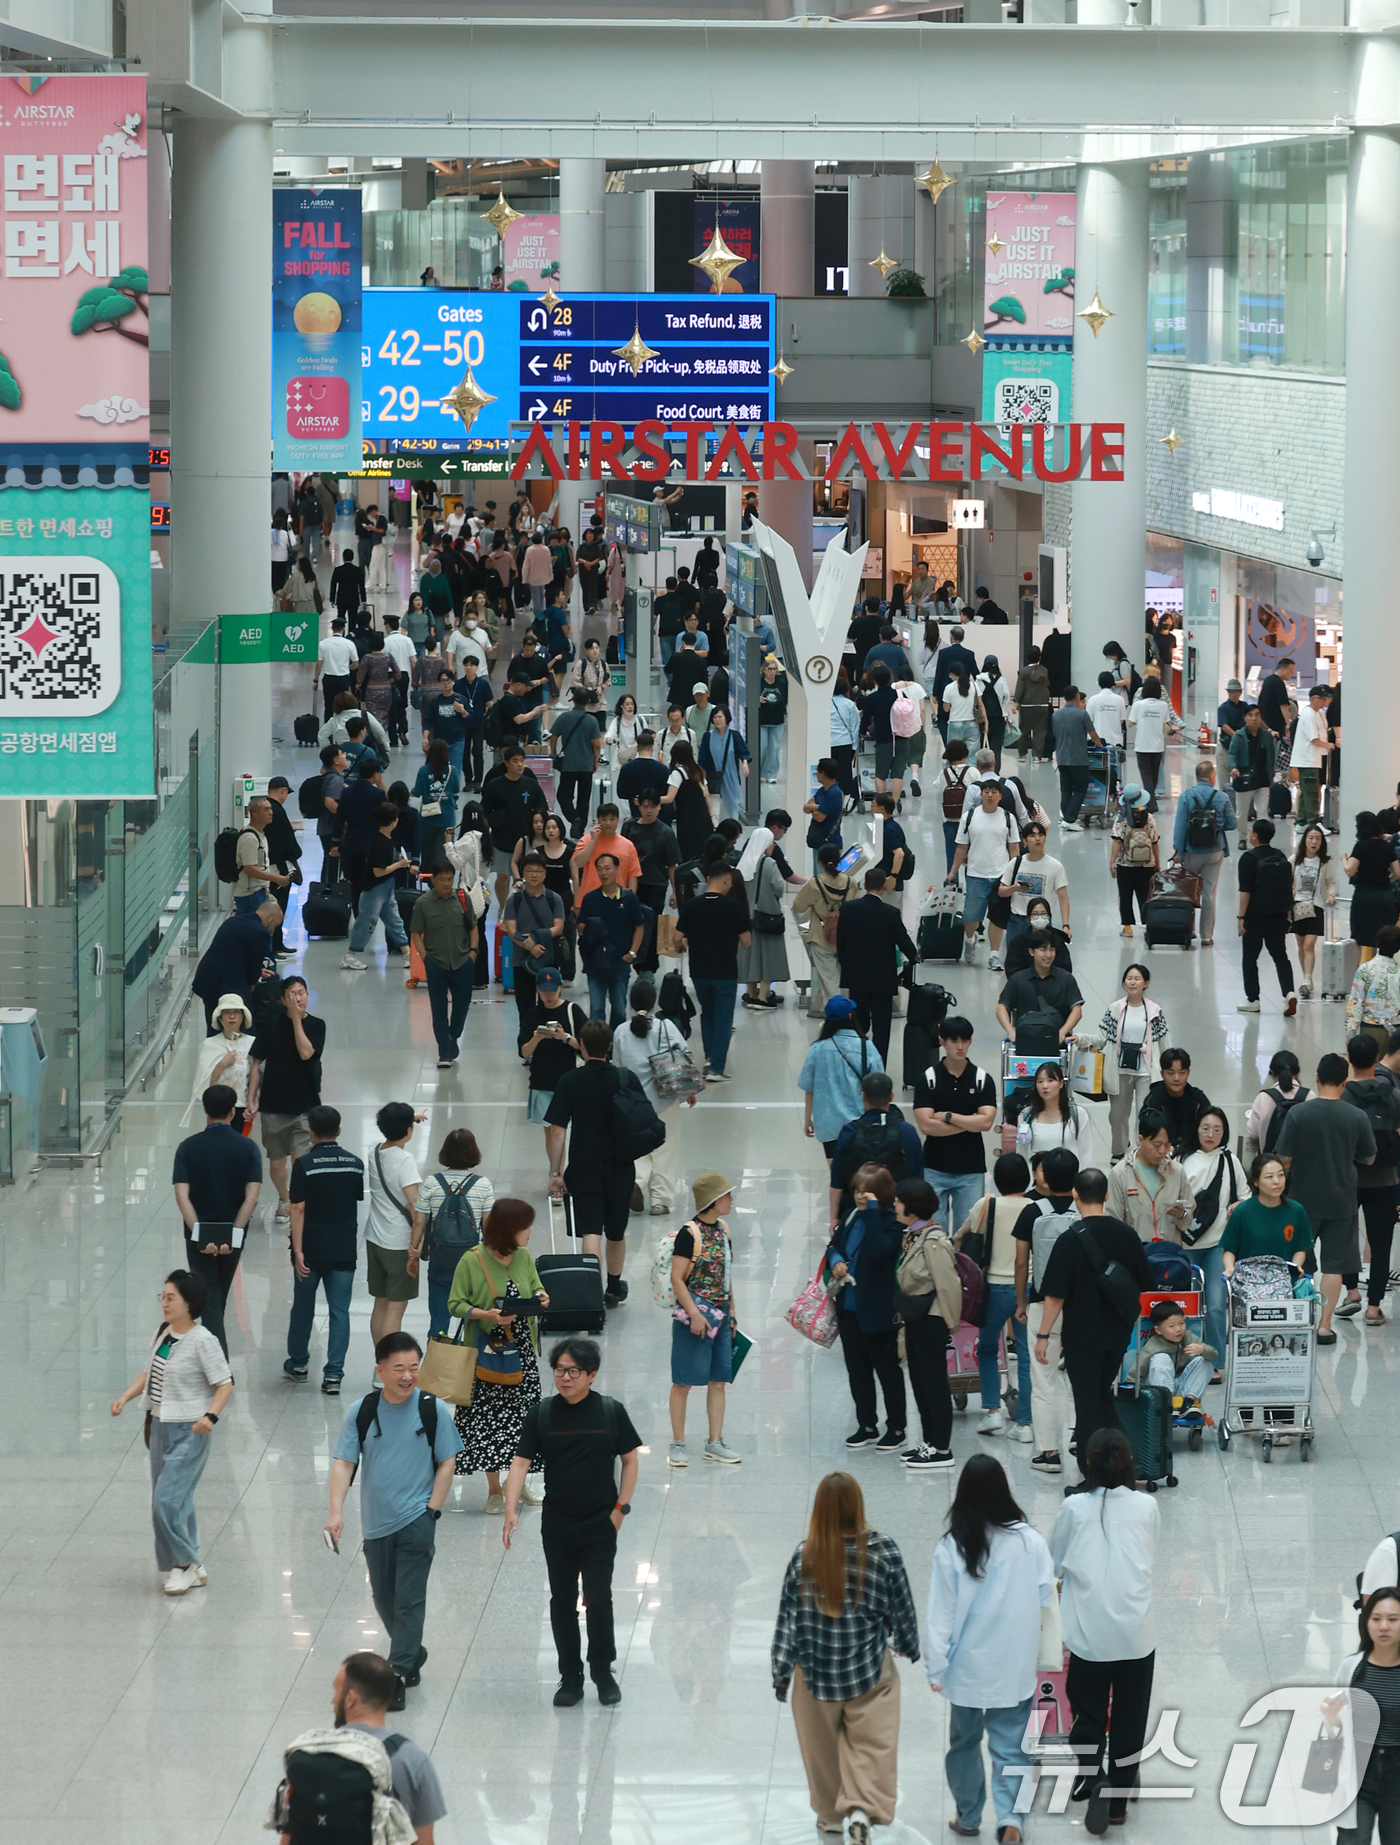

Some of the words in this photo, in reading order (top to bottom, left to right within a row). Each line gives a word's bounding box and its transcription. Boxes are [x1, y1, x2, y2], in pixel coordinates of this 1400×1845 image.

[13, 105, 75, 119] AIRSTAR
[284, 221, 351, 249] FALL
[519, 235, 545, 246] JUST
[1010, 225, 1051, 243] JUST
[4, 220, 121, 278] 면세
[309, 249, 325, 261] for
[516, 247, 536, 258] USE
[537, 247, 548, 258] IT
[1006, 244, 1036, 260] USE
[1040, 244, 1055, 261] IT
[284, 261, 351, 276] SHOPPING
[512, 258, 552, 270] AIRSTAR
[998, 262, 1062, 280] AIRSTAR
[437, 305, 483, 323] Gates
[553, 307, 573, 326] 28
[665, 313, 687, 329] Tax
[689, 313, 736, 330] Refund,
[738, 313, 762, 330] 退税
[553, 329, 567, 337] 90m
[296, 356, 320, 364] Golden
[552, 352, 573, 371] 4F
[312, 364, 335, 372] Falling
[589, 359, 617, 377] Duty
[645, 359, 692, 377] Pick-up,
[693, 359, 762, 375] 免税品领取处
[553, 375, 567, 383] 10m
[552, 398, 572, 417] 4F
[656, 403, 687, 419] Food
[688, 404, 724, 420] Court,
[726, 404, 762, 420] 美食街
[296, 416, 340, 427] AIRSTAR
[286, 444, 319, 452] INCHEON
[320, 444, 350, 452] AIRPORT
[510, 419, 805, 482] AIRSTAR
[823, 419, 1125, 483] AVENUE
[396, 457, 424, 469] Desk
[461, 459, 504, 473] Transfer
[367, 469, 392, 478] Airlines
[39, 517, 114, 539] 면세쇼핑
[239, 628, 263, 640] AED
[282, 643, 305, 653] AED
[0, 731, 118, 754] 공항면세점앱
